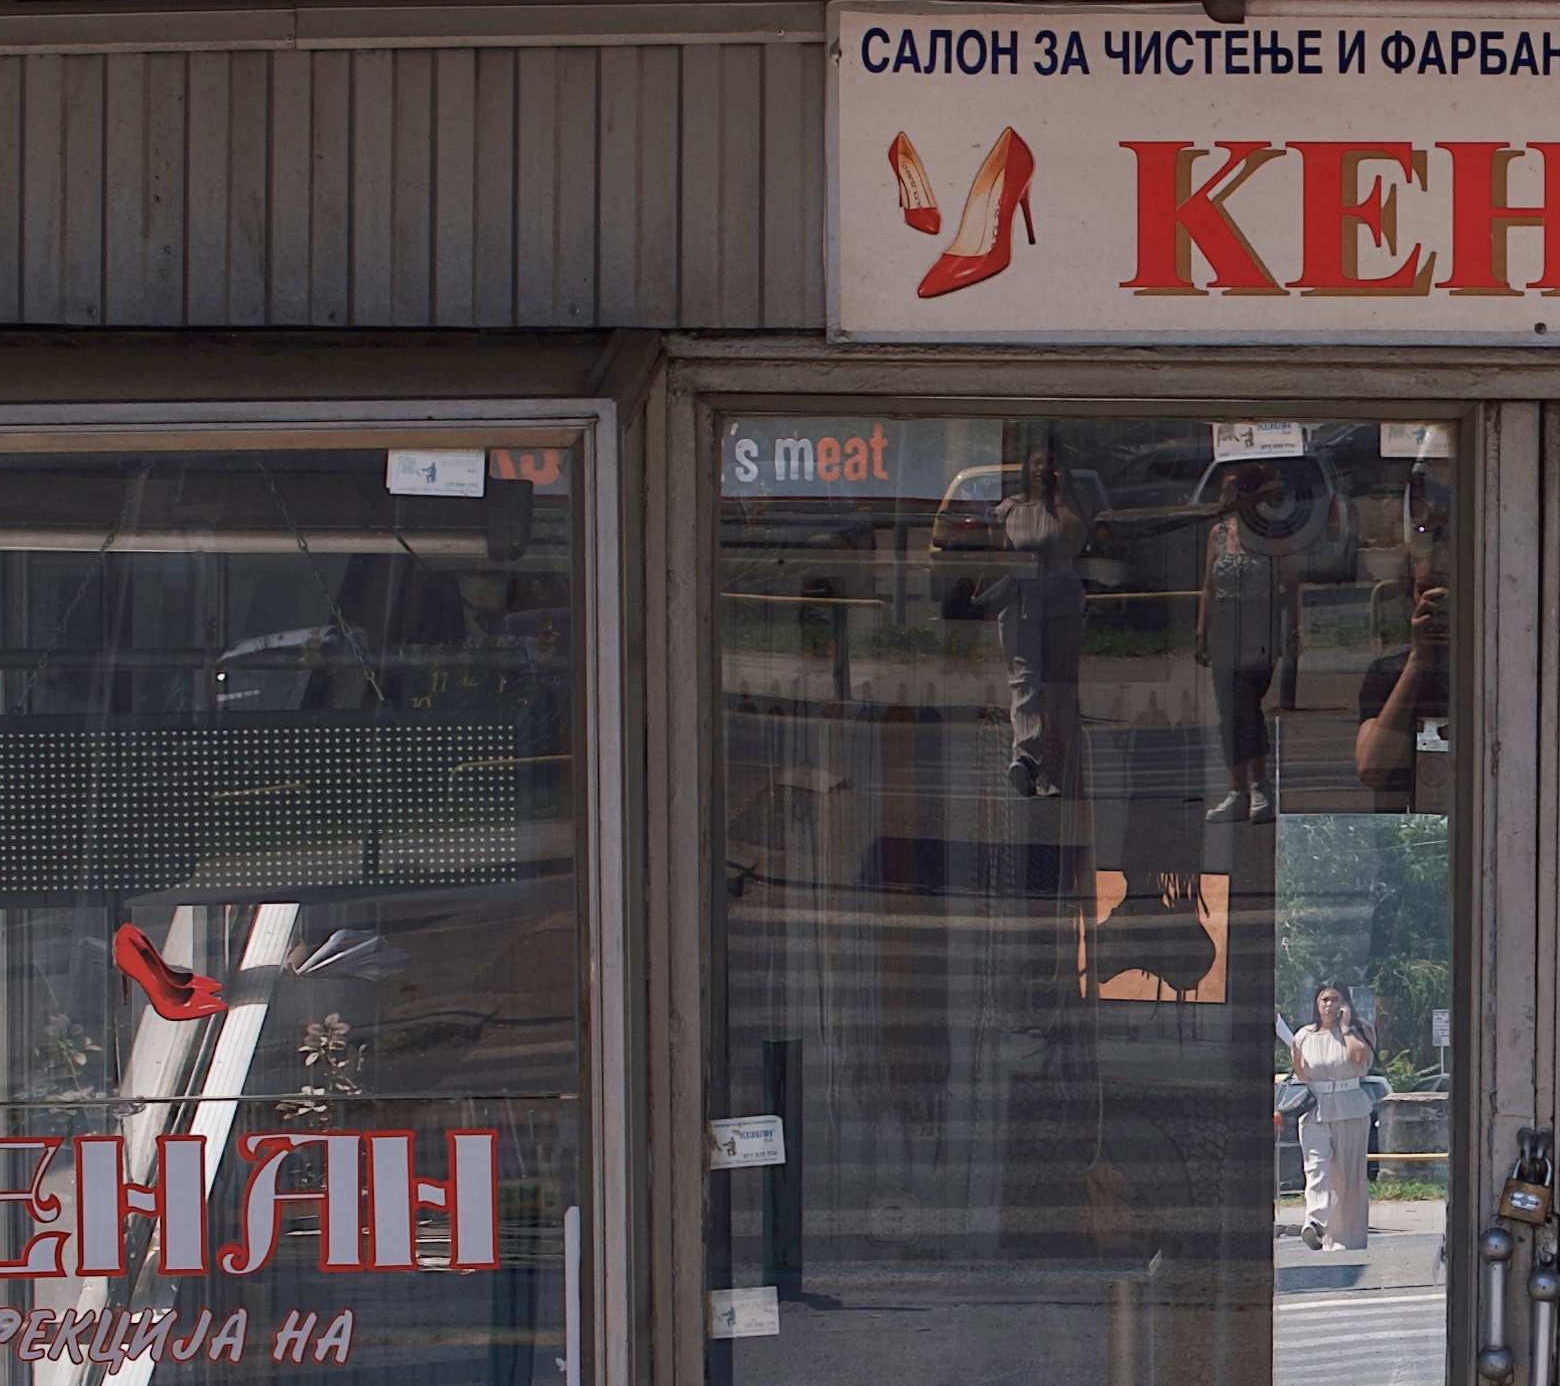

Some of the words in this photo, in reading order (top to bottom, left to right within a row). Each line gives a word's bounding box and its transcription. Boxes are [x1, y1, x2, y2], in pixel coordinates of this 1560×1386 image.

[861, 28, 1018, 74] САЛОН
[1034, 29, 1090, 75] ЗА
[1104, 29, 1323, 75] ЧИСТЕЊЕ
[1338, 31, 1366, 74] И
[775, 422, 888, 481] meat
[271, 1307, 354, 1366] НА
